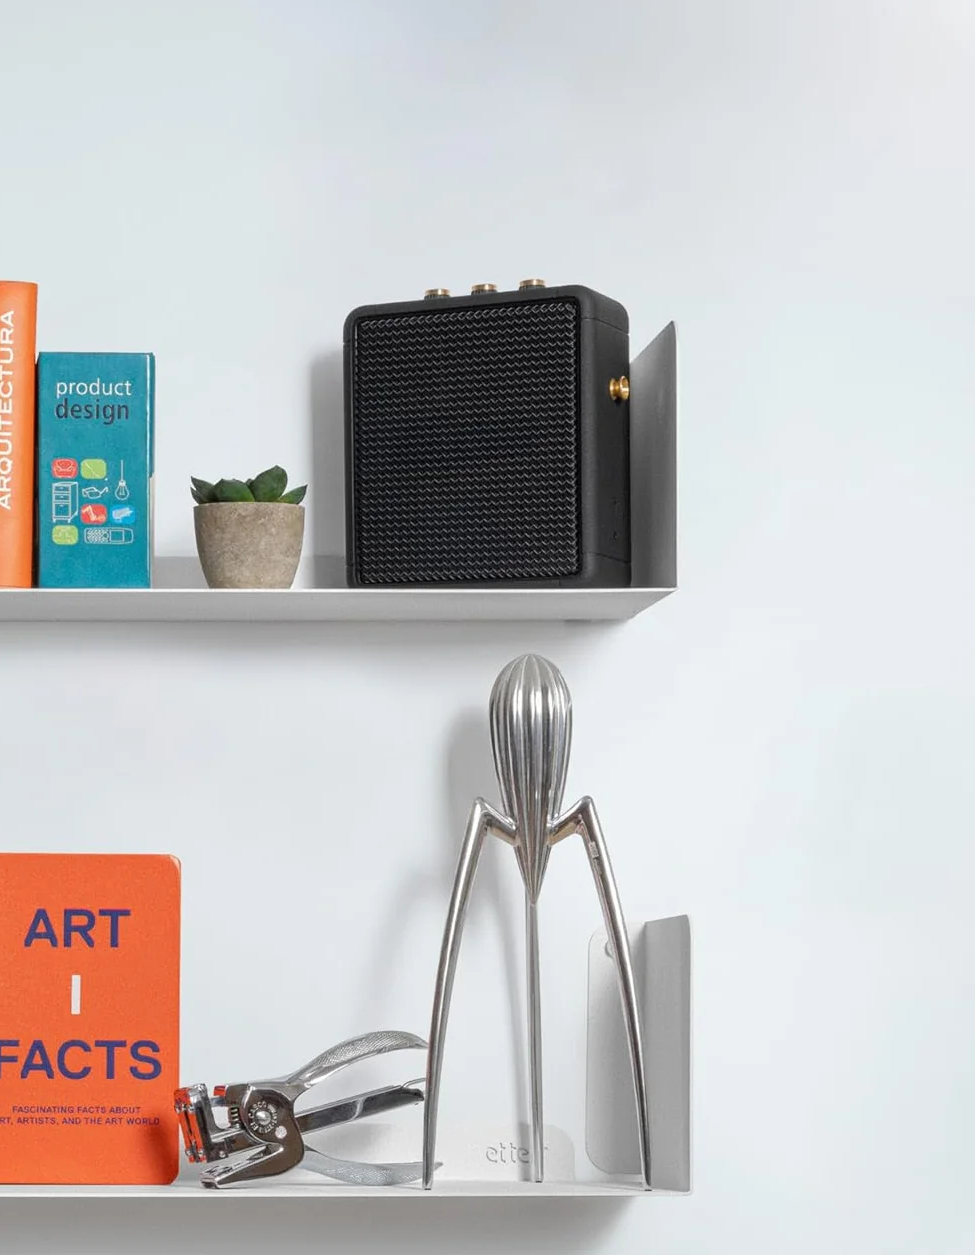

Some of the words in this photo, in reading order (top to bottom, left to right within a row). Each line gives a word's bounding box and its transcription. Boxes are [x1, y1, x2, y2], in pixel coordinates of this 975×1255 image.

[56, 378, 132, 398] product
[55, 398, 130, 425] design
[24, 908, 132, 948] ART
[12, 1105, 74, 1114] FASCINATING
[77, 1106, 106, 1114] FACTS
[109, 1106, 142, 1114] ABOUT
[16, 1117, 60, 1126] ARTISTS,
[61, 1117, 82, 1125] AND
[85, 1117, 103, 1125] THE
[105, 1117, 123, 1125] ART
[126, 1117, 160, 1125] WORLD
